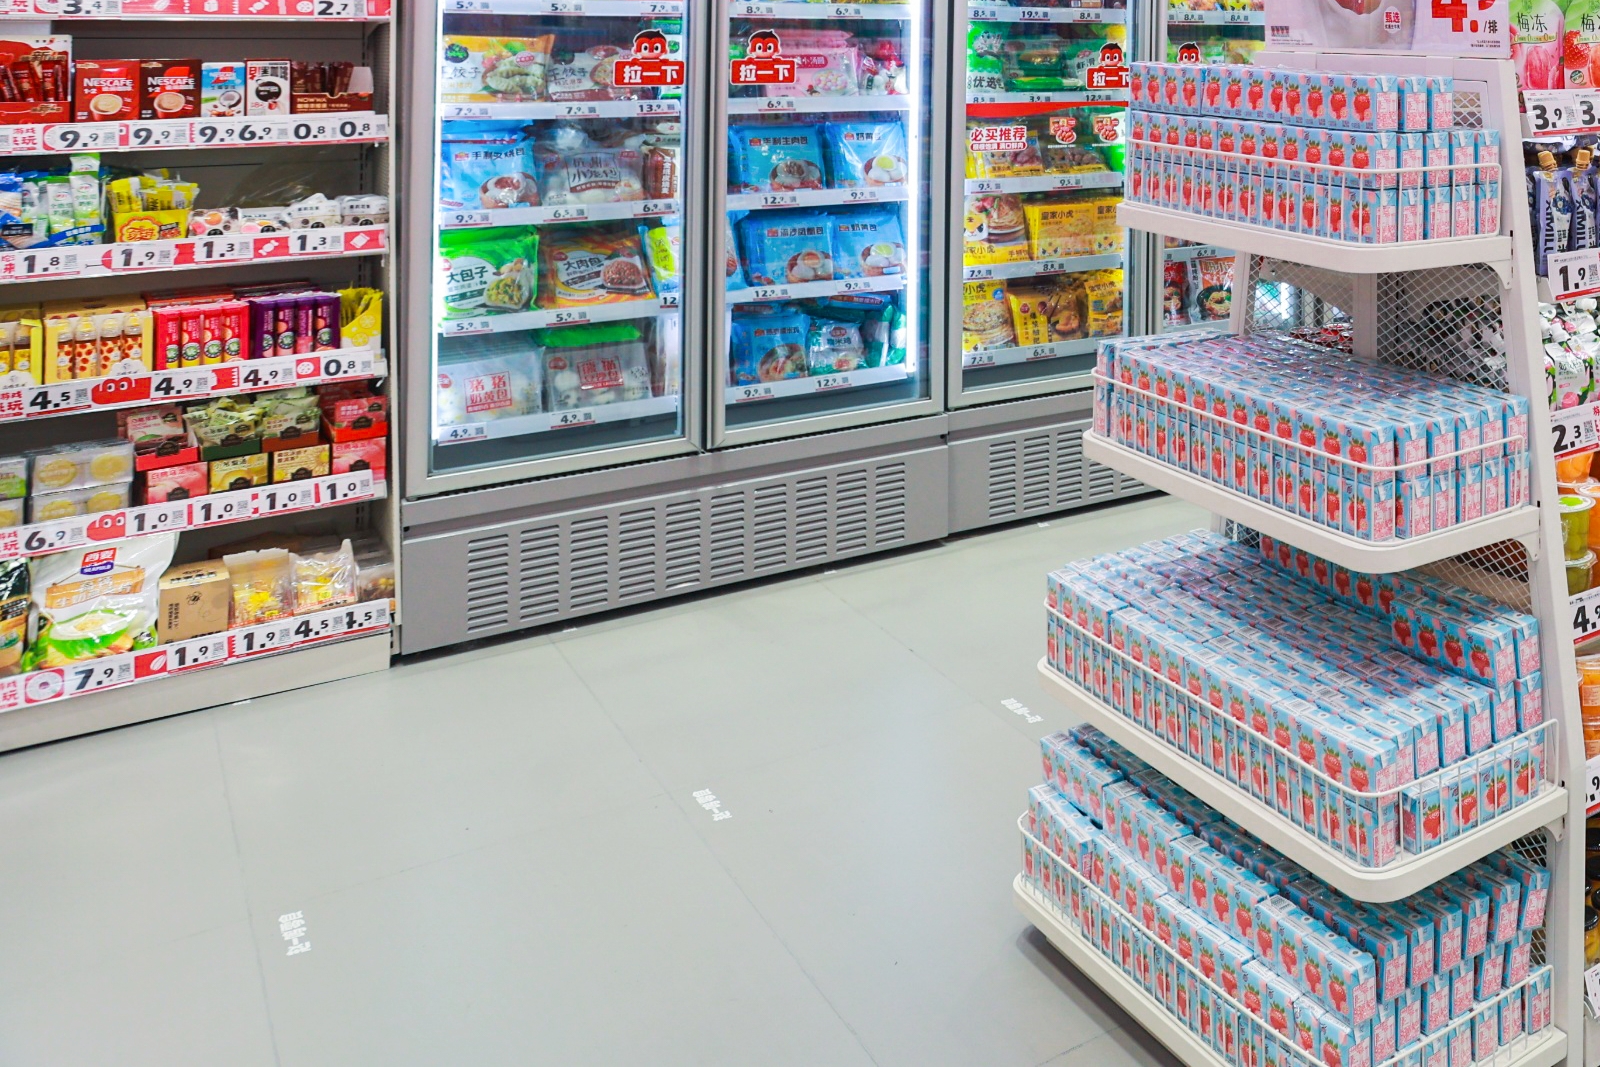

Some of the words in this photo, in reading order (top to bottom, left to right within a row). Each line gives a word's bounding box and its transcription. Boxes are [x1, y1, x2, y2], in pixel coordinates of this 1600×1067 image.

[317, 0, 349, 16] 2.7
[1385, 11, 1401, 24] 甄选
[1516, 12, 1548, 33] 梅冻
[623, 65, 679, 83] 拉一下
[739, 64, 790, 82] 拉一下
[1532, 104, 1563, 132] 3.9
[134, 127, 171, 146] 9.9
[199, 125, 235, 144] 9.9
[239, 124, 272, 142] 6.9
[293, 123, 326, 140] 0.8
[339, 120, 371, 137] 0.8
[970, 126, 1026, 142] 必买推荐
[59, 129, 99, 150] 9.9
[1041, 210, 1075, 221] 皇家小虎
[202, 240, 235, 258] 1.3
[297, 234, 328, 251] 1.3
[23, 254, 60, 274] 1.8
[120, 247, 155, 266] 1.9
[562, 257, 602, 271] 大肉包
[446, 265, 489, 285] 大包子
[1558, 264, 1587, 292] 1.9
[324, 358, 356, 376] 0.8
[154, 376, 193, 396] 4.9
[242, 369, 279, 388] 4.9
[29, 390, 71, 410] 4.5
[470, 390, 508, 404] 奶黄包
[1552, 424, 1581, 454] 2.3
[327, 482, 357, 501] 1.0
[265, 492, 298, 511] 1.0
[134, 512, 168, 531] 1.0
[200, 503, 233, 522] 1.0
[24, 530, 66, 552] 6.9
[294, 619, 329, 638] 4.5
[243, 631, 275, 651] 1.9
[175, 645, 209, 667] 1.9
[75, 668, 114, 690] 7.9
